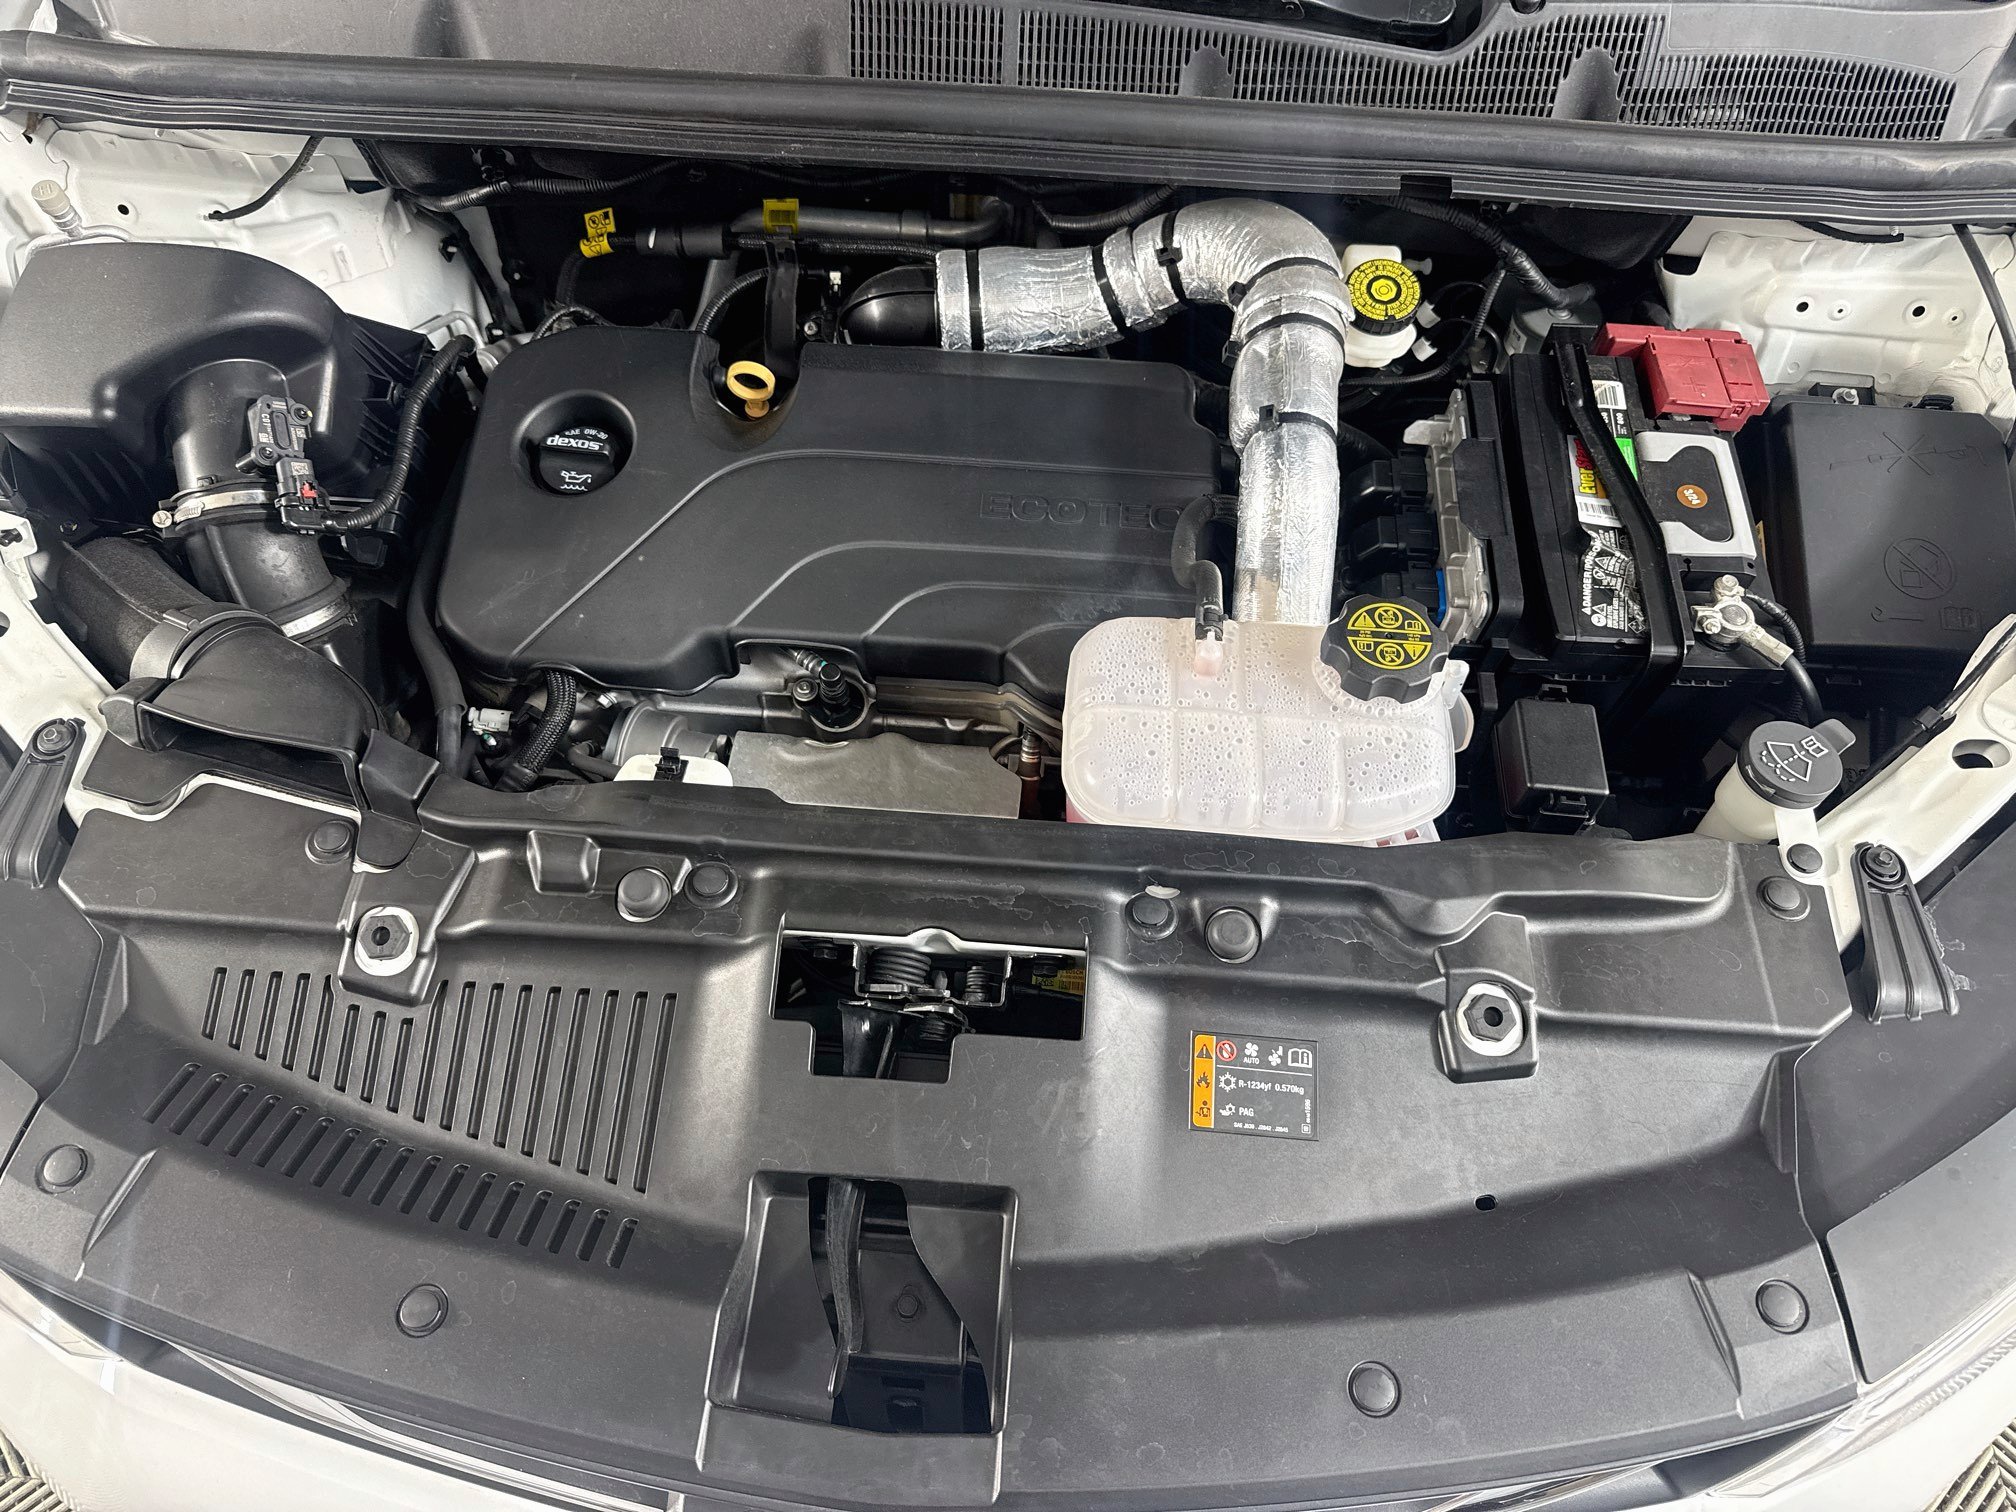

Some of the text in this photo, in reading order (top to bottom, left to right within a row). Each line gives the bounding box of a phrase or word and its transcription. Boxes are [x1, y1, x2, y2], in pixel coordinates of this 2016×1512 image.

[584, 428, 609, 440] 0W-20
[546, 434, 604, 451] dexos
[1683, 488, 1701, 505] 3/24
[1243, 1056, 1260, 1065] AUTO
[1238, 1079, 1305, 1095] R-1234yf 0.570kg
[1238, 1107, 1254, 1117] PAG
